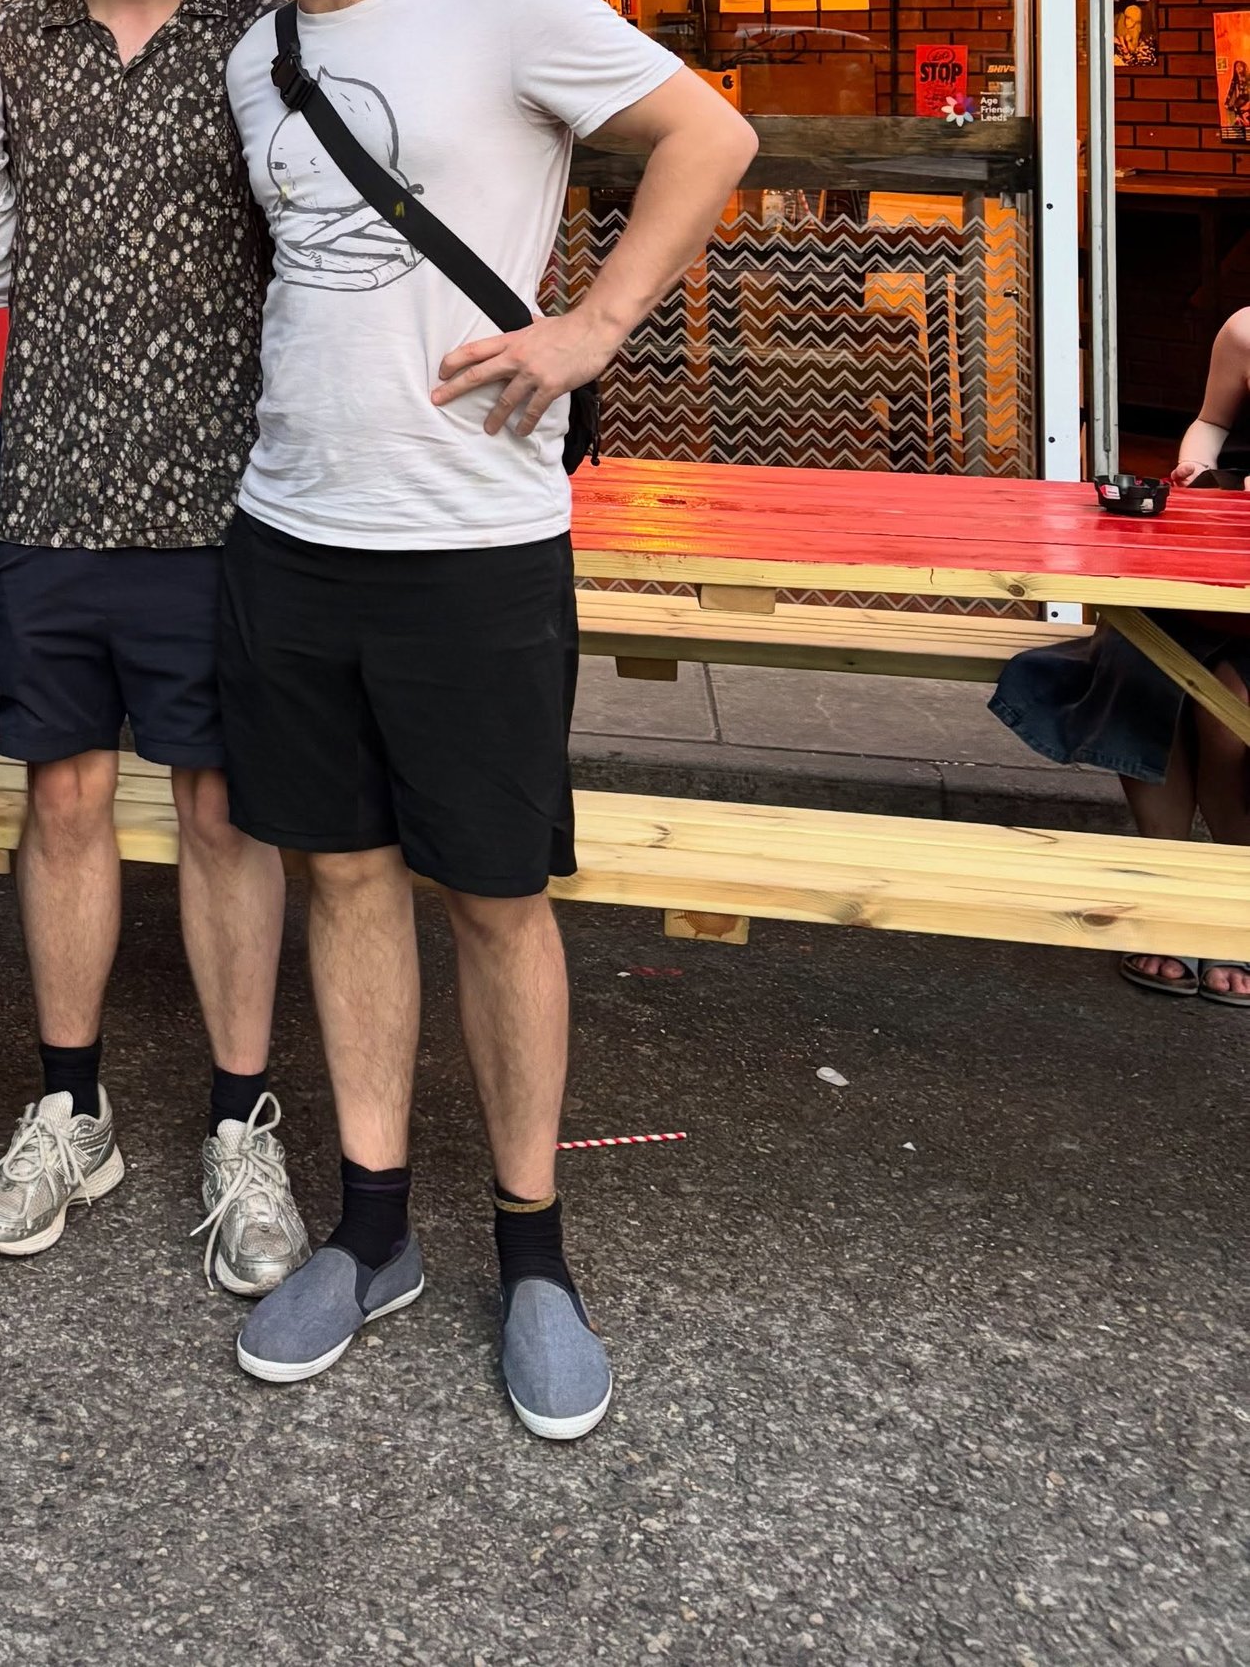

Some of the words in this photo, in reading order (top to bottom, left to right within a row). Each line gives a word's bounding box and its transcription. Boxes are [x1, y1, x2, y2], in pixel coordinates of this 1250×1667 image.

[920, 61, 963, 83] STOP
[980, 97, 998, 106] Age
[981, 106, 1015, 115] Friendly
